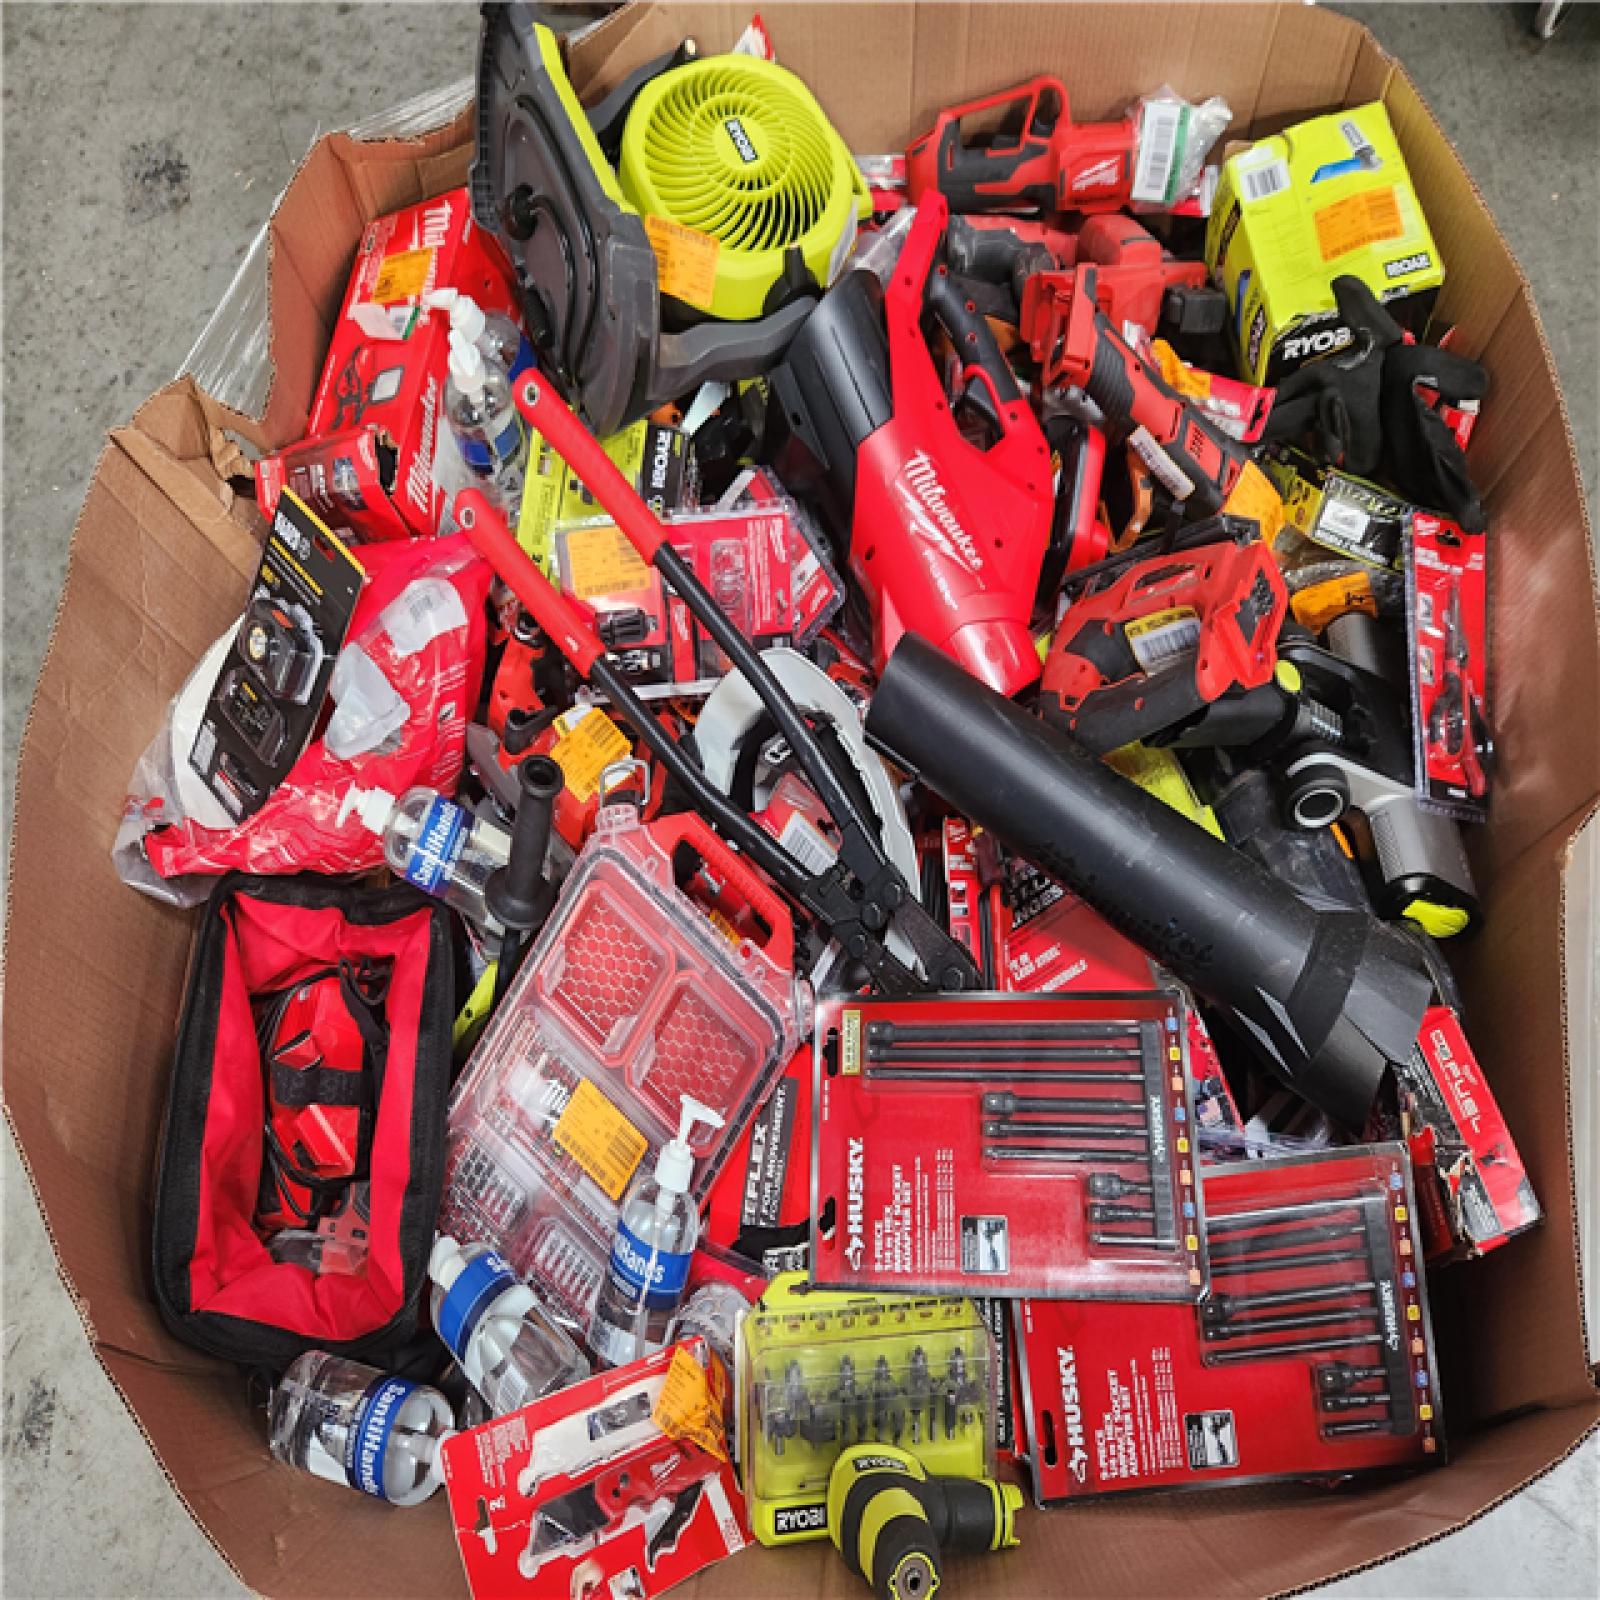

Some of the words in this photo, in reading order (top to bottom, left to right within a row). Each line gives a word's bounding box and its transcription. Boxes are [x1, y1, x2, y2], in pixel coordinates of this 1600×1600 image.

[1282, 327, 1352, 361] RYOB
[904, 449, 983, 570] Milwaukee
[847, 1137, 864, 1235] HUSKY
[1057, 1345, 1085, 1446] HUSKY
[776, 1506, 826, 1532] RYOBI
